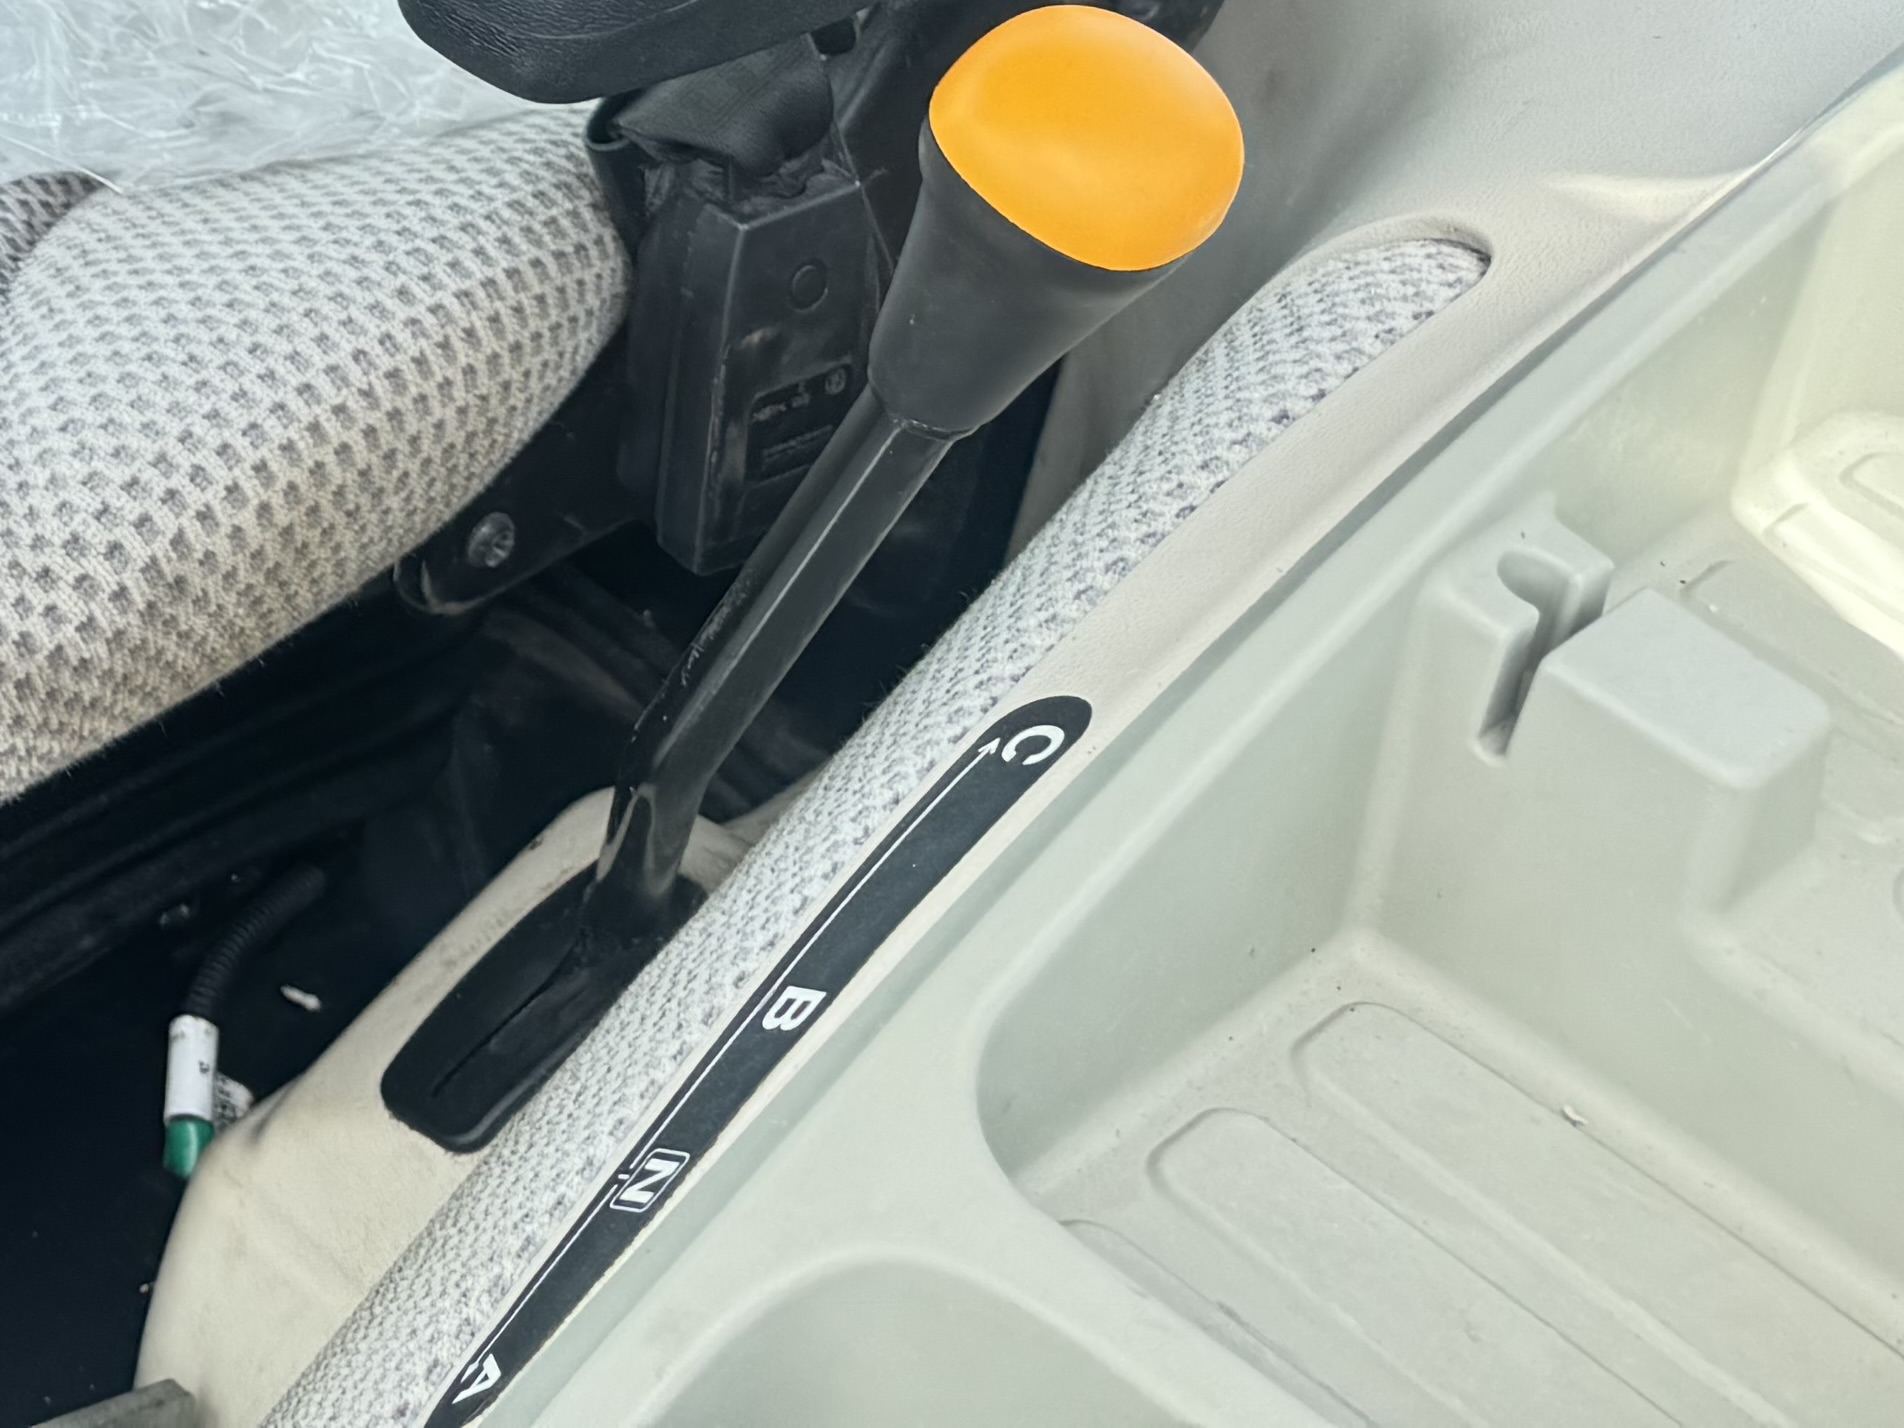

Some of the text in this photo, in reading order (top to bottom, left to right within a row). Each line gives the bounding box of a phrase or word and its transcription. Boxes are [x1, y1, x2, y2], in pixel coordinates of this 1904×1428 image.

[1001, 725, 1065, 765] C
[762, 986, 827, 1031] B
[619, 1158, 680, 1204] N
[452, 1353, 501, 1404] A
